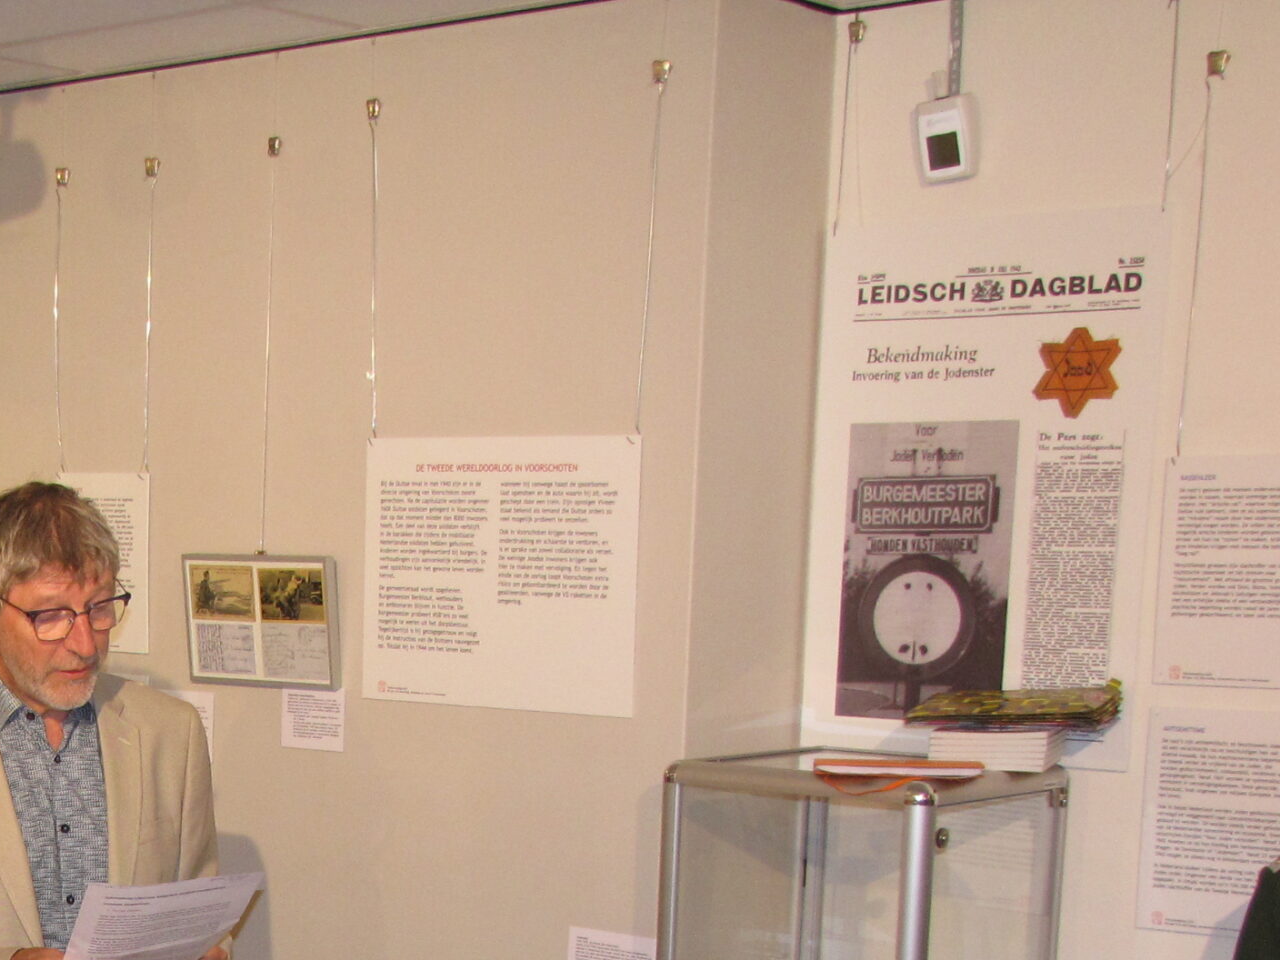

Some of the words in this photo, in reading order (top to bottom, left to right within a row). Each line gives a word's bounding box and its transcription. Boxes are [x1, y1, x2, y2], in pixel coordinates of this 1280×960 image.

[857, 282, 966, 305] LEIDSCH
[1010, 273, 1142, 298] DAGBLAD
[867, 345, 978, 365] Bekendmaking
[852, 369, 901, 383] Invoering
[904, 371, 924, 380] van
[927, 368, 940, 380] de
[944, 366, 995, 381] Jodenster
[915, 424, 938, 437] Voor
[415, 464, 425, 472] DE
[426, 464, 454, 472] TWEEDE
[456, 464, 513, 472] WERELDOORLOG
[515, 464, 523, 472] IN
[524, 463, 578, 472] VOORSCHOTEN
[863, 484, 986, 503] BURGEMEESTER
[861, 506, 984, 525] BERKHOUTPARK
[870, 538, 908, 552] HONDEN
